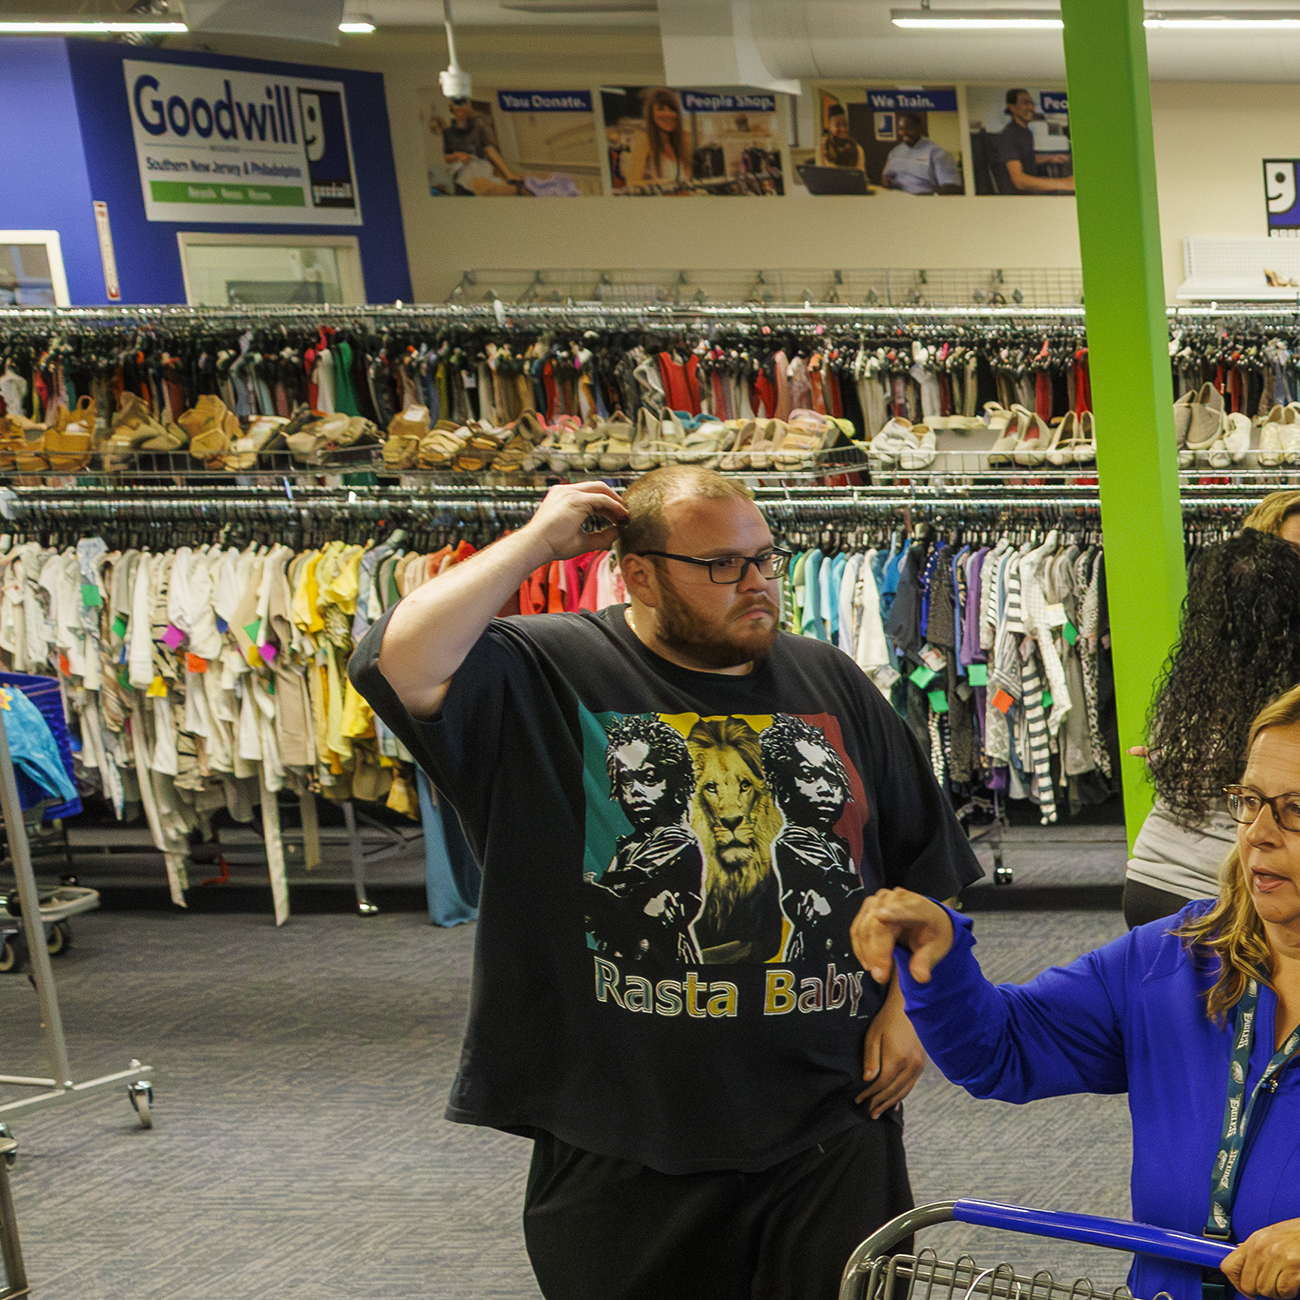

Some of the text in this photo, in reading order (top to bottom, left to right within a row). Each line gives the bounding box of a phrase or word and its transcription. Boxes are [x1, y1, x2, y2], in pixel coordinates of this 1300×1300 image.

[133, 74, 297, 144] Goodwill
[501, 93, 587, 109] You Donate.
[685, 93, 775, 111] People Shop.
[871, 94, 935, 109] We Train.
[594, 955, 865, 1018] Rasta Baby
